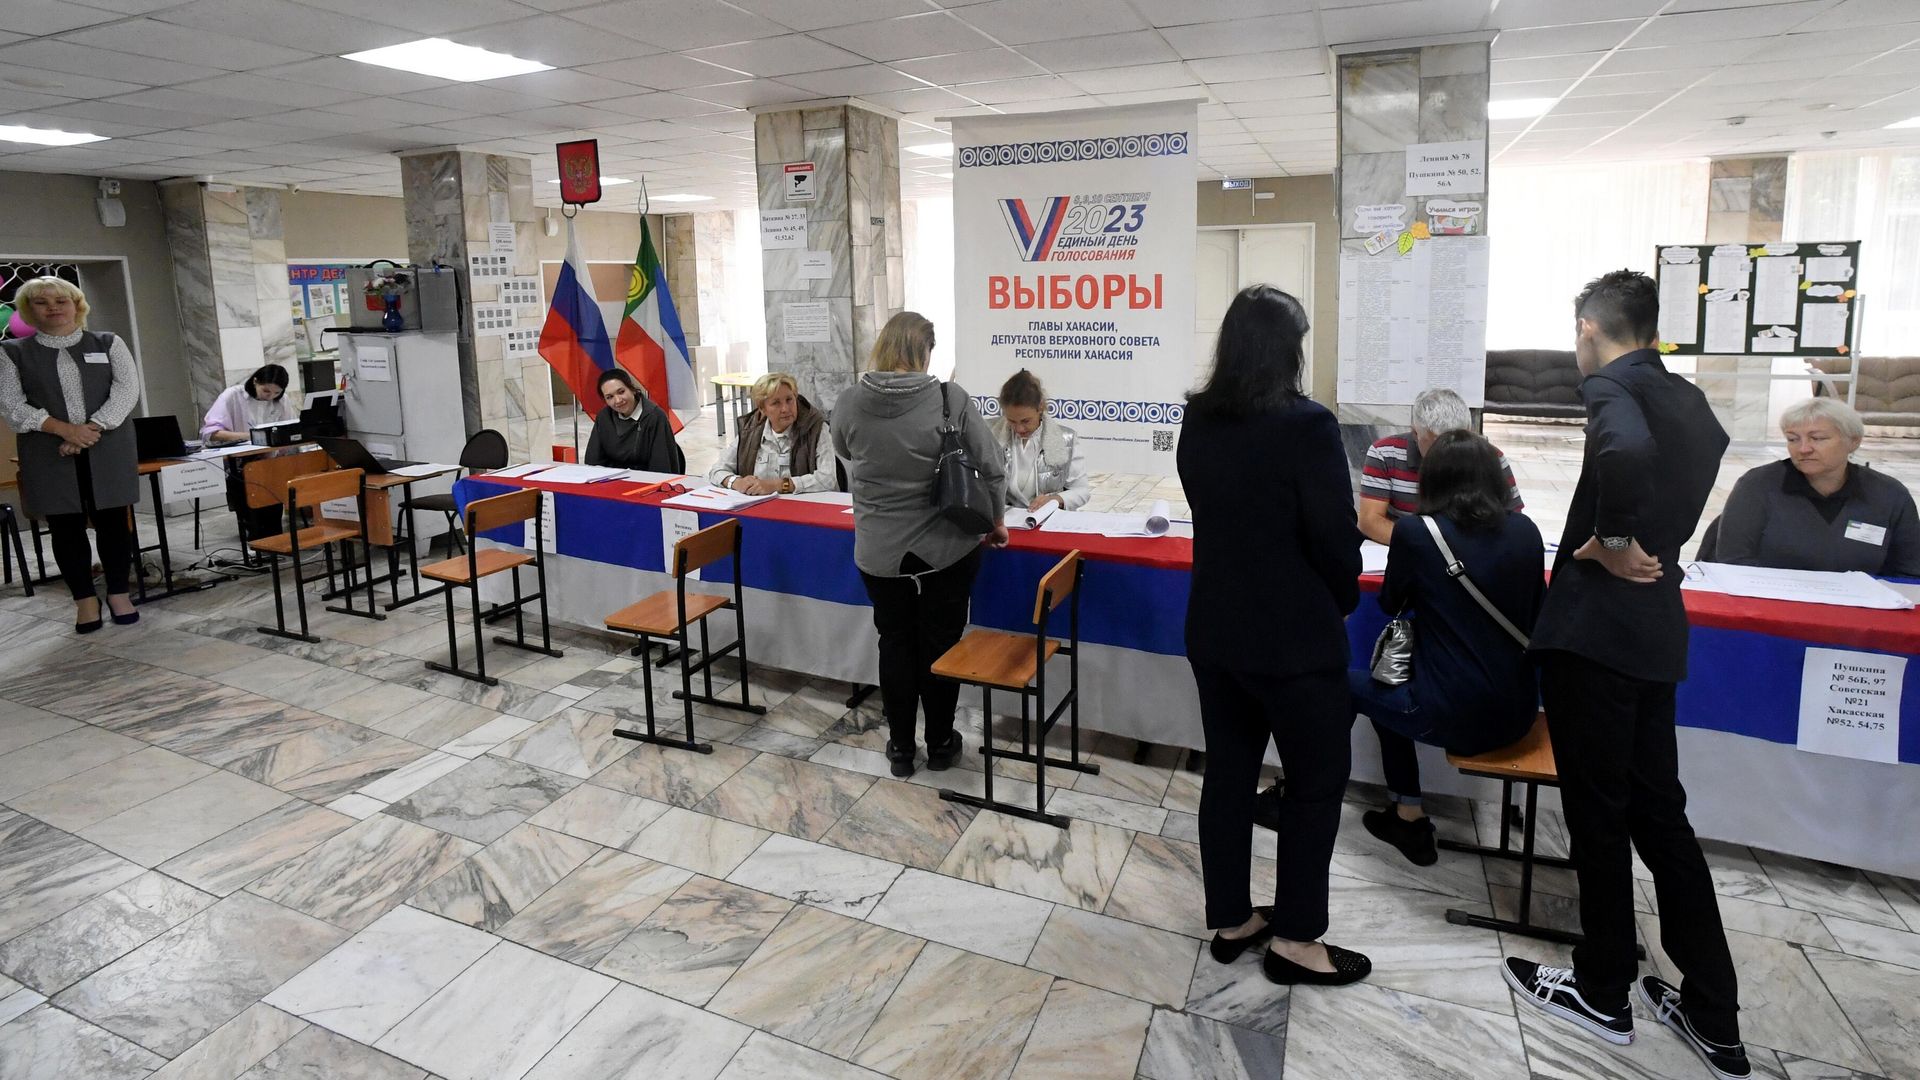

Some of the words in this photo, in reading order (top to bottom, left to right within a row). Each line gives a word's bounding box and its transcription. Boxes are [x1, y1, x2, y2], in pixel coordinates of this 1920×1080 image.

[1409, 171, 1445, 179] Пушкина
[1104, 192, 1151, 203] СЕНТЯБРЯ
[1063, 204, 1147, 235] 2023
[1057, 235, 1107, 248] ЕДИНЫЙ
[1107, 235, 1138, 249] ДЕНЬ
[1051, 249, 1136, 262] ГОЛОСОВАНИЯ
[988, 274, 1163, 310] ВЫБОРЫ
[1028, 321, 1063, 332] ГЛАВЫ
[1066, 321, 1119, 333] ХАКАСИИ,
[991, 335, 1046, 346] ДЕПУТАТОВ
[1049, 335, 1116, 346] ВЕРХОВНОГО
[1119, 336, 1160, 347] СОВЕТА
[1015, 349, 1081, 360] РЕСПУБЛИКИ
[1084, 350, 1133, 361] ХАКАСИЯ
[1834, 662, 1886, 674] Пушкина
[1832, 673, 1844, 681] №
[1848, 675, 1870, 685] 56Б,
[1873, 678, 1886, 686] 97
[1829, 684, 1886, 696] Советская
[1845, 697, 1868, 706] №21
[1828, 706, 1885, 719] Хакасская
[1827, 717, 1855, 728] №52,
[1858, 721, 1885, 731] 54,75
